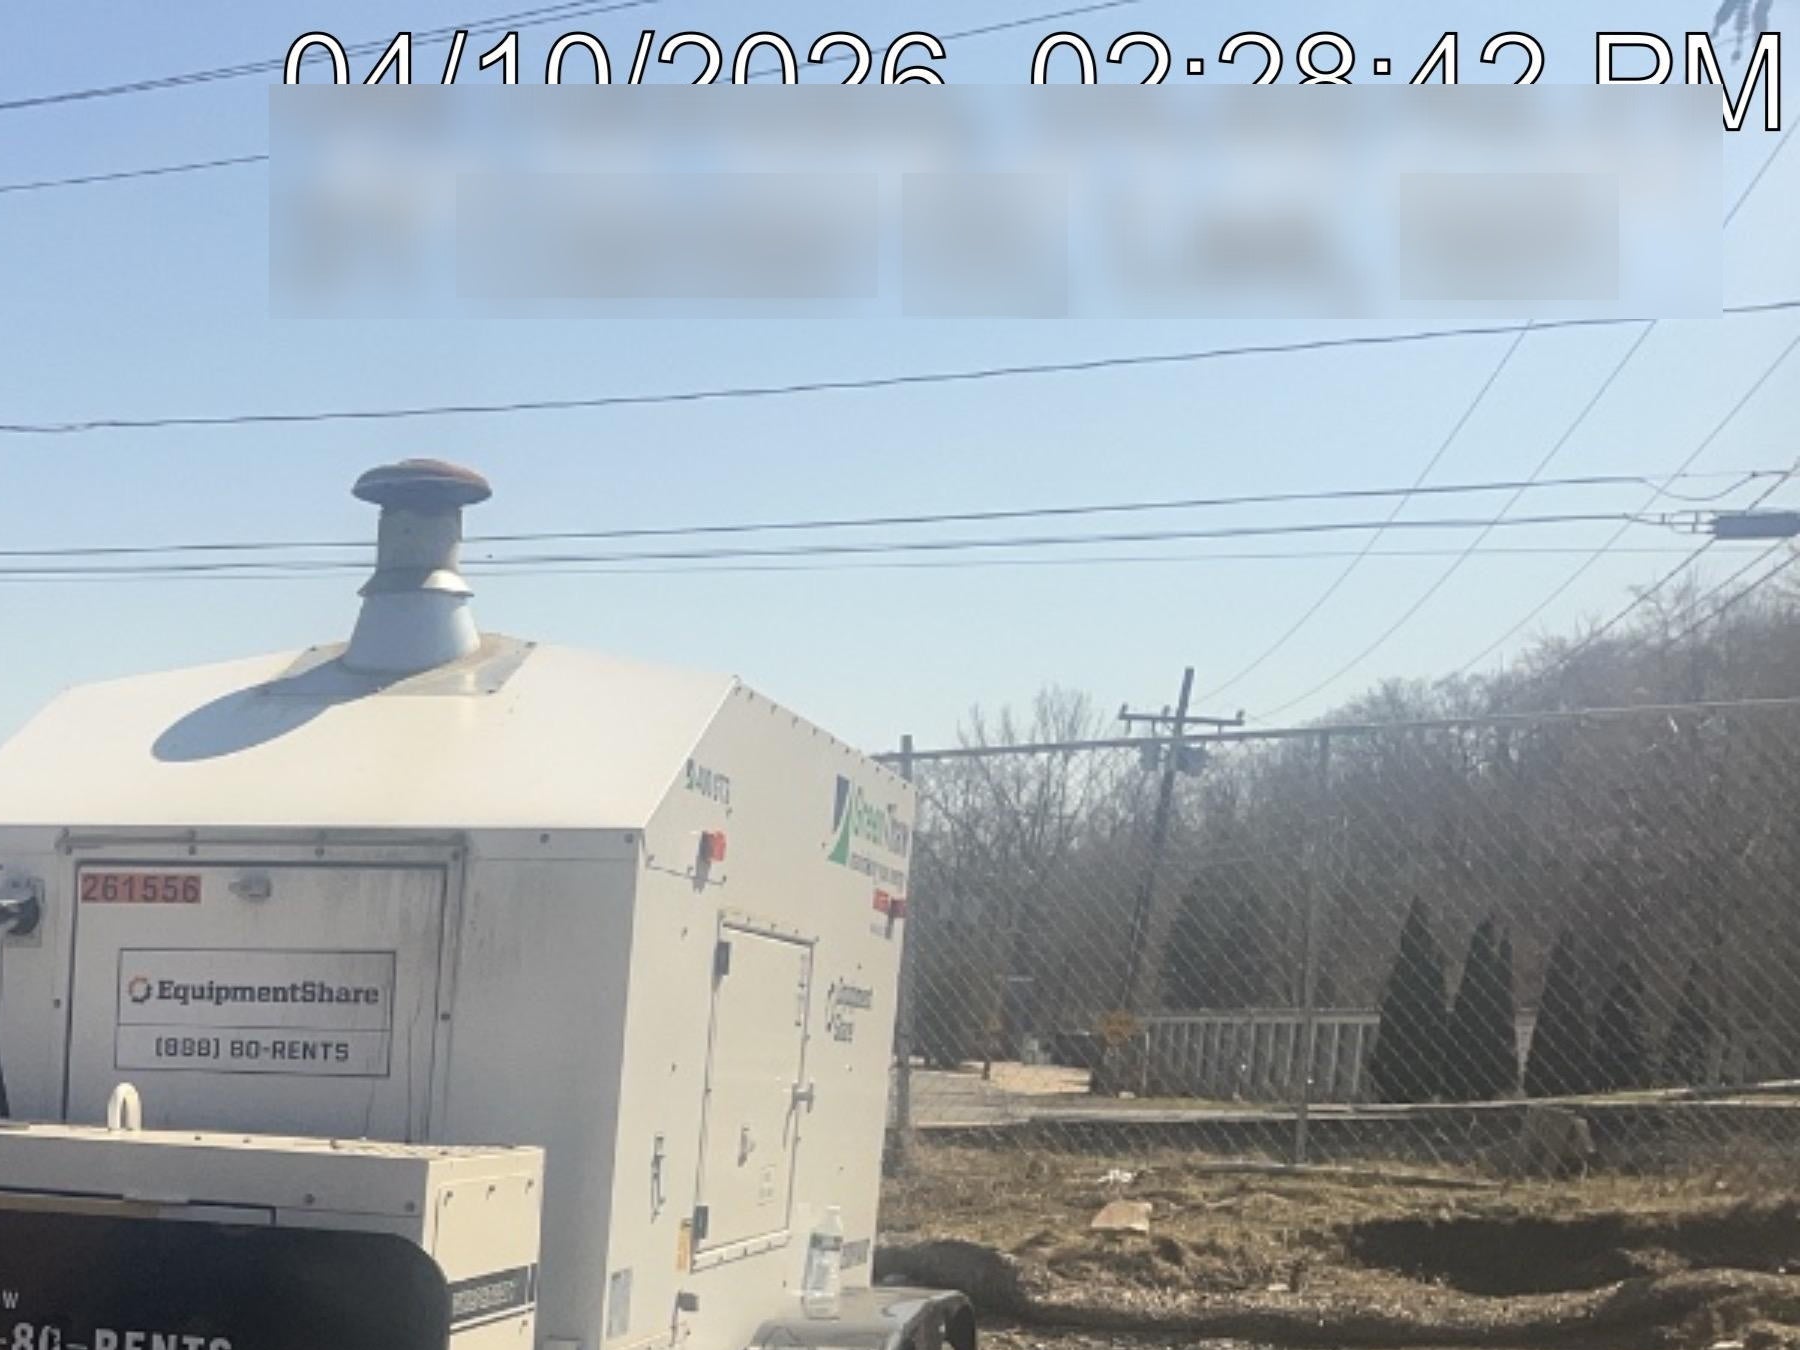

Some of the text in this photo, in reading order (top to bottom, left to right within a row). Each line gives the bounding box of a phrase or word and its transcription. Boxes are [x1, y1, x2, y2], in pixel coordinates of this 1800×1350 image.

[80, 874, 200, 904] 261556
[157, 979, 379, 1007] EquipmentShare
[229, 1039, 349, 1062] 80-RENTS
